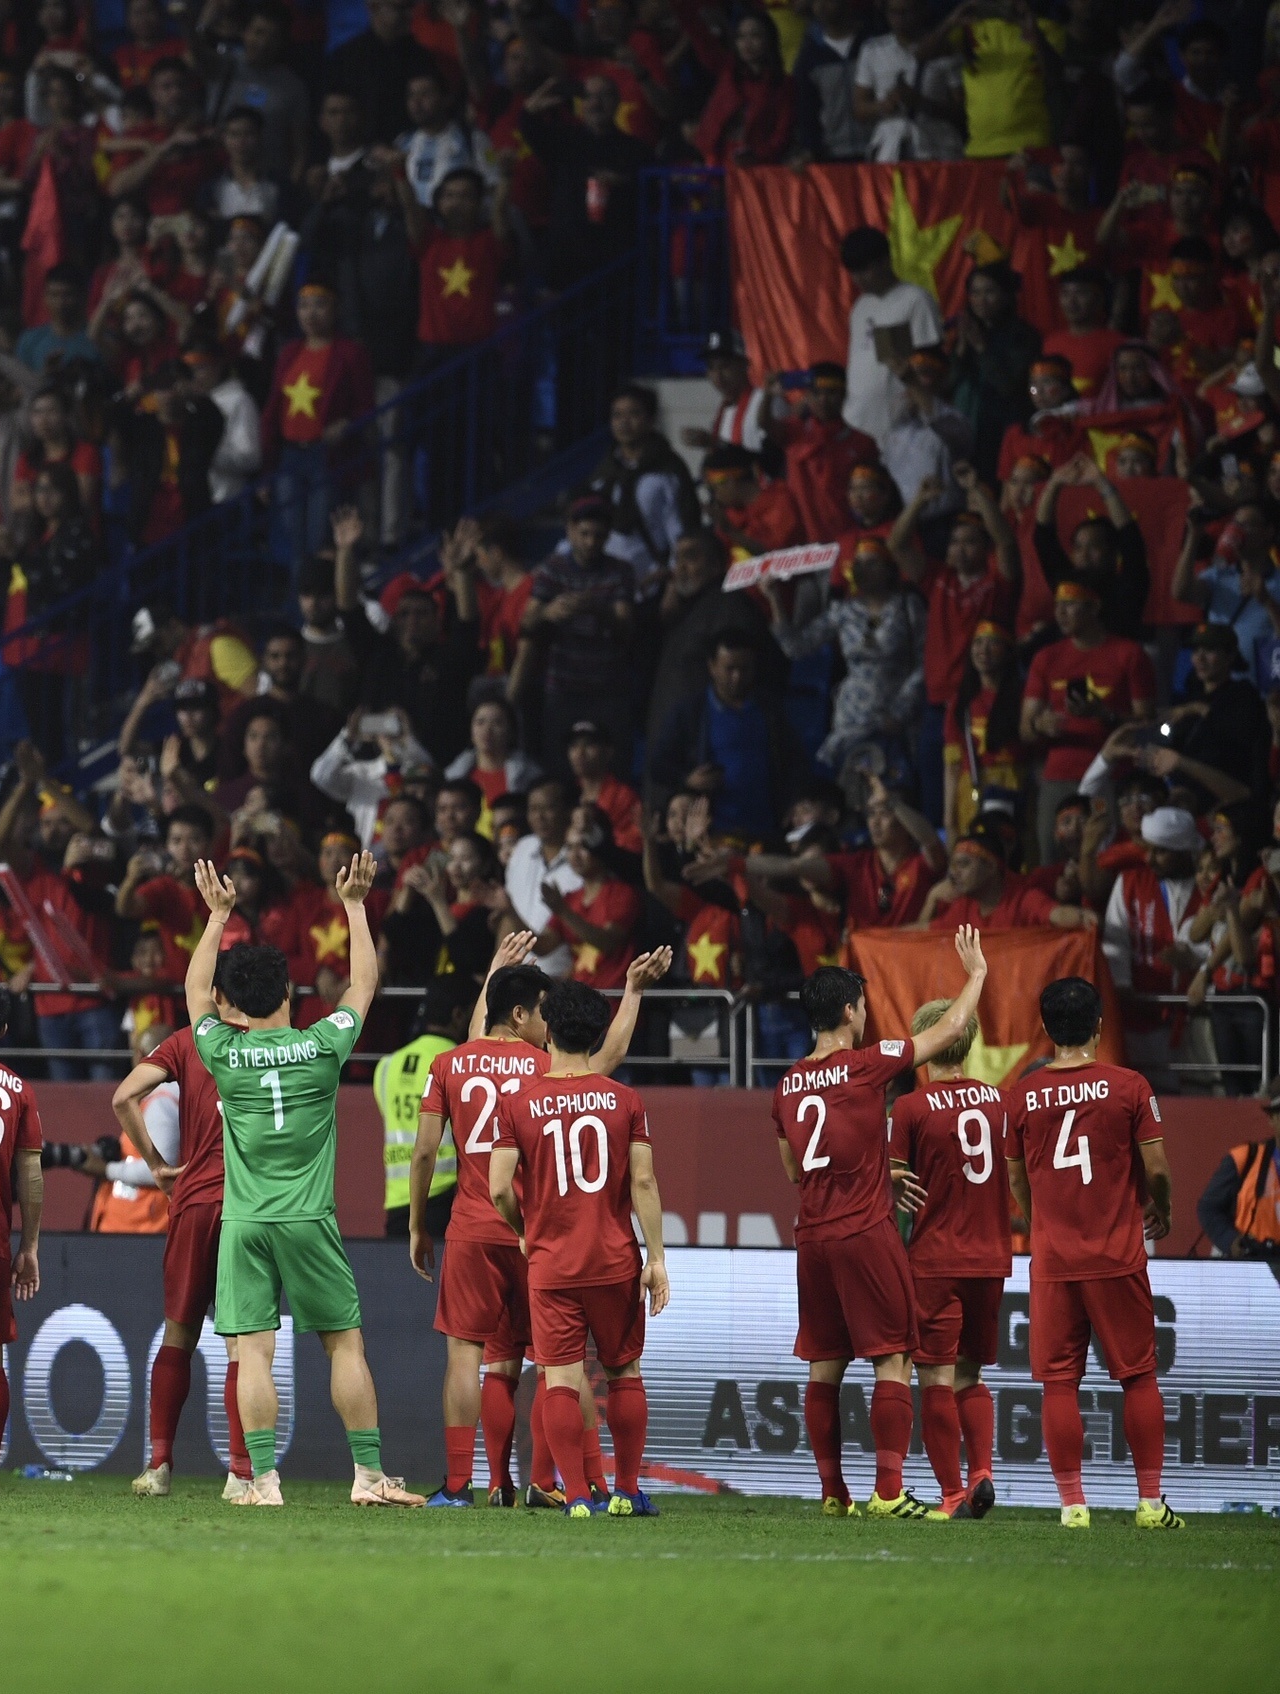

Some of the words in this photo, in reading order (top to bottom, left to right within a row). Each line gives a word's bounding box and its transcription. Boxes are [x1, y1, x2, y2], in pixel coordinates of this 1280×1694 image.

[277, 1040, 318, 1066] DUNG
[451, 1054, 535, 1076] N.T.CHUNG
[260, 1070, 284, 1131] 1
[528, 1091, 617, 1119] N.C.PHUONG
[926, 1085, 1001, 1112] N.V.TOAN
[1026, 1080, 1109, 1112] B.T.DUNG
[543, 1114, 609, 1198] 10
[796, 1094, 831, 1173] 2
[957, 1108, 993, 1185] 9
[1053, 1109, 1093, 1185] 4
